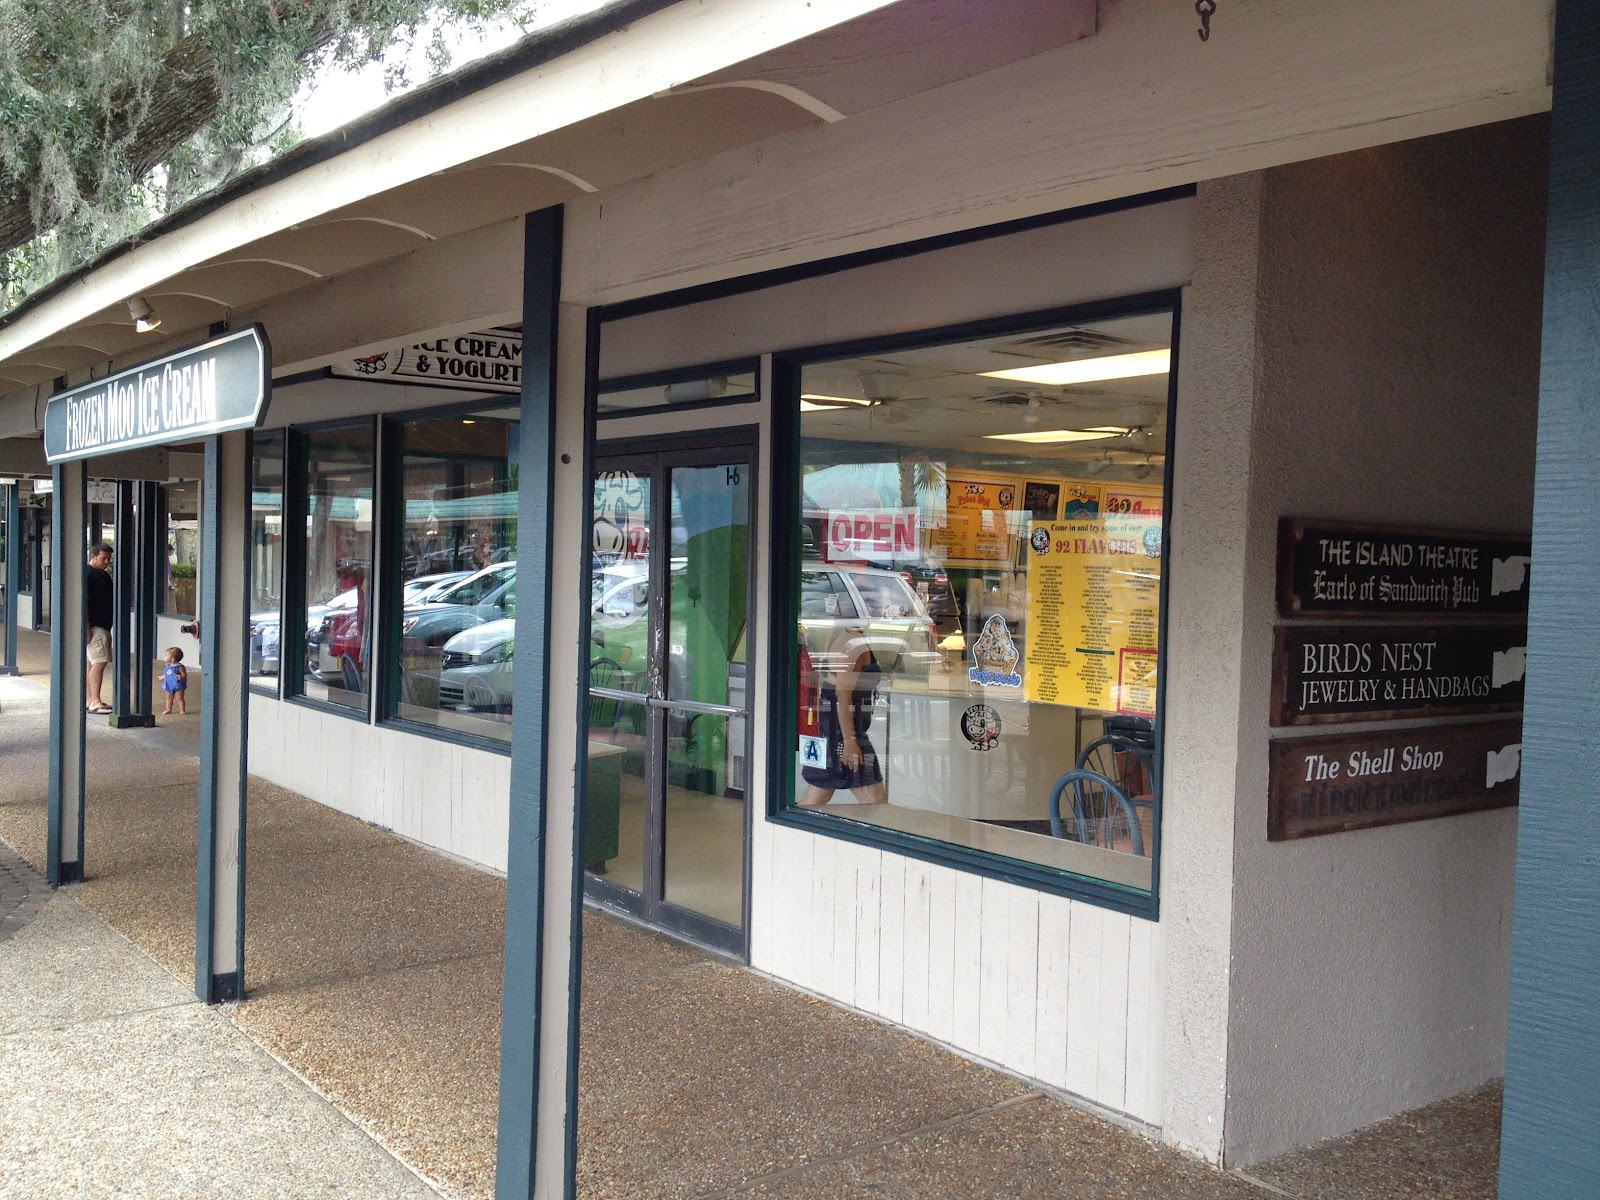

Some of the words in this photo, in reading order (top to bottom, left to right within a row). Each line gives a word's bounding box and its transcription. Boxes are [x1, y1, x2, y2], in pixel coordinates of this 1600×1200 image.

[413, 338, 449, 353] CE
[416, 354, 430, 373] &
[436, 356, 522, 381] YOGURT
[66, 392, 105, 451] FROZEN
[107, 380, 135, 442] MOO
[138, 372, 160, 436] ICE
[162, 357, 217, 431] CREAM
[831, 513, 915, 553] OPEN
[1051, 523, 1068, 532] Come
[1069, 523, 1076, 532] in
[1077, 523, 1088, 532] and
[1089, 523, 1099, 533] try
[1055, 540, 1070, 554] 92
[1319, 539, 1351, 566] THE
[1355, 541, 1413, 567] ISLAND
[1417, 545, 1479, 570] THEATRE
[1312, 569, 1357, 601] Earle
[1359, 575, 1376, 601] of
[1378, 574, 1449, 608] Sandwich
[1451, 576, 1480, 608] Pub
[1301, 643, 1371, 674] BIRDS
[1380, 641, 1437, 672] NEST
[1299, 679, 1381, 711] JEWELRY
[1383, 679, 1397, 700] &
[1401, 675, 1490, 700] HANDBAGS
[807, 740, 819, 761] A
[1304, 754, 1340, 782] The
[1346, 747, 1395, 778] Shell
[1400, 745, 1444, 772] Shop
